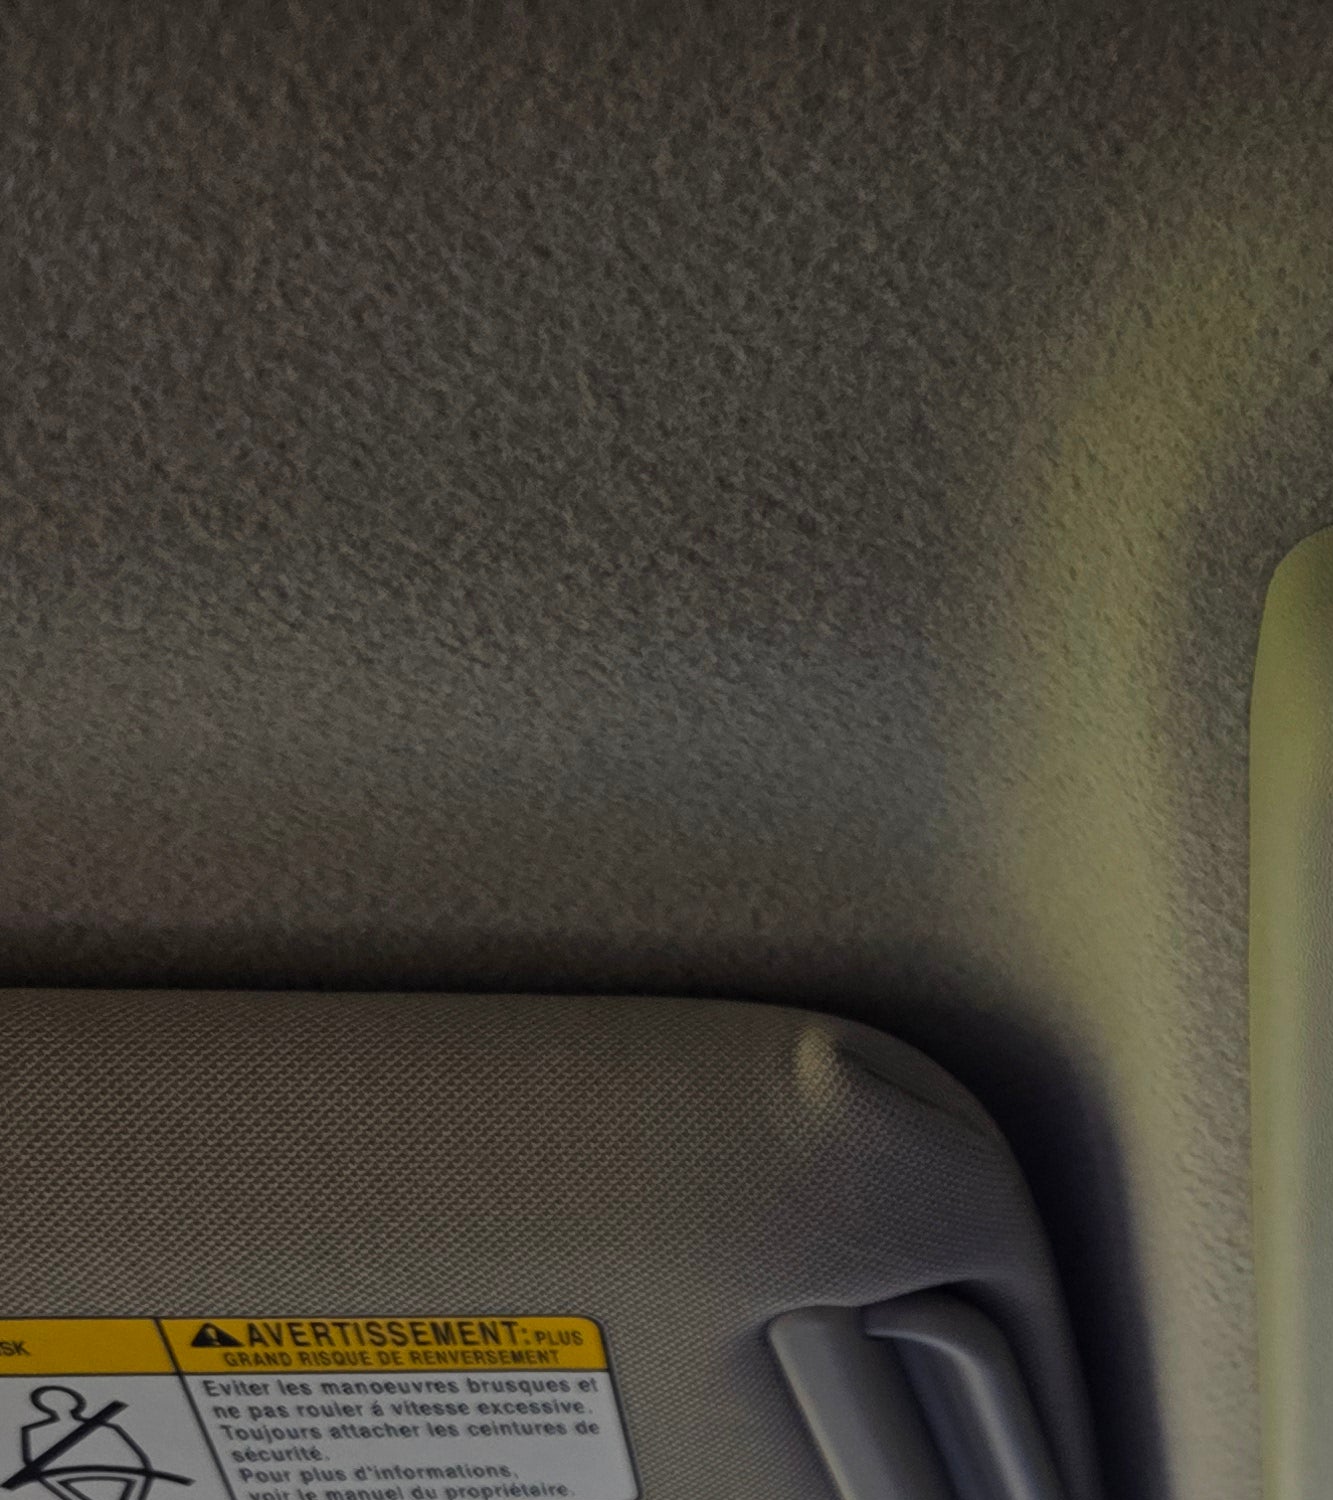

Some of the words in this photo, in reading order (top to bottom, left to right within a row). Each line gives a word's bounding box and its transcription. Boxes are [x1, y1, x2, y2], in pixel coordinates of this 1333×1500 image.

[247, 1321, 532, 1348] AVERTISSEMENT:
[535, 1330, 585, 1346] PLUS
[0, 1341, 31, 1356] SK
[223, 1352, 293, 1367] GRAND
[299, 1351, 373, 1366] RISQUE
[377, 1351, 405, 1366] DE
[409, 1349, 561, 1366] RENVERSEMENT
[202, 1379, 271, 1398] Eviter
[277, 1379, 312, 1396] les
[321, 1379, 460, 1396] manoeuvres
[466, 1377, 571, 1396] brusques
[578, 1376, 599, 1393] et
[213, 1405, 241, 1419] ne
[248, 1404, 290, 1422] pas
[296, 1401, 364, 1418] rouler
[391, 1401, 471, 1416] vitesse
[477, 1400, 594, 1415] excessive.
[220, 1424, 323, 1444] Toujours
[329, 1423, 420, 1440] attacher
[426, 1422, 460, 1437] les
[467, 1421, 568, 1437] ceintures
[575, 1420, 600, 1435] de
[231, 1446, 331, 1463] sécurité.
[239, 1467, 292, 1484] Pour
[300, 1467, 348, 1486] plus
[411, 1485, 438, 1500] du
